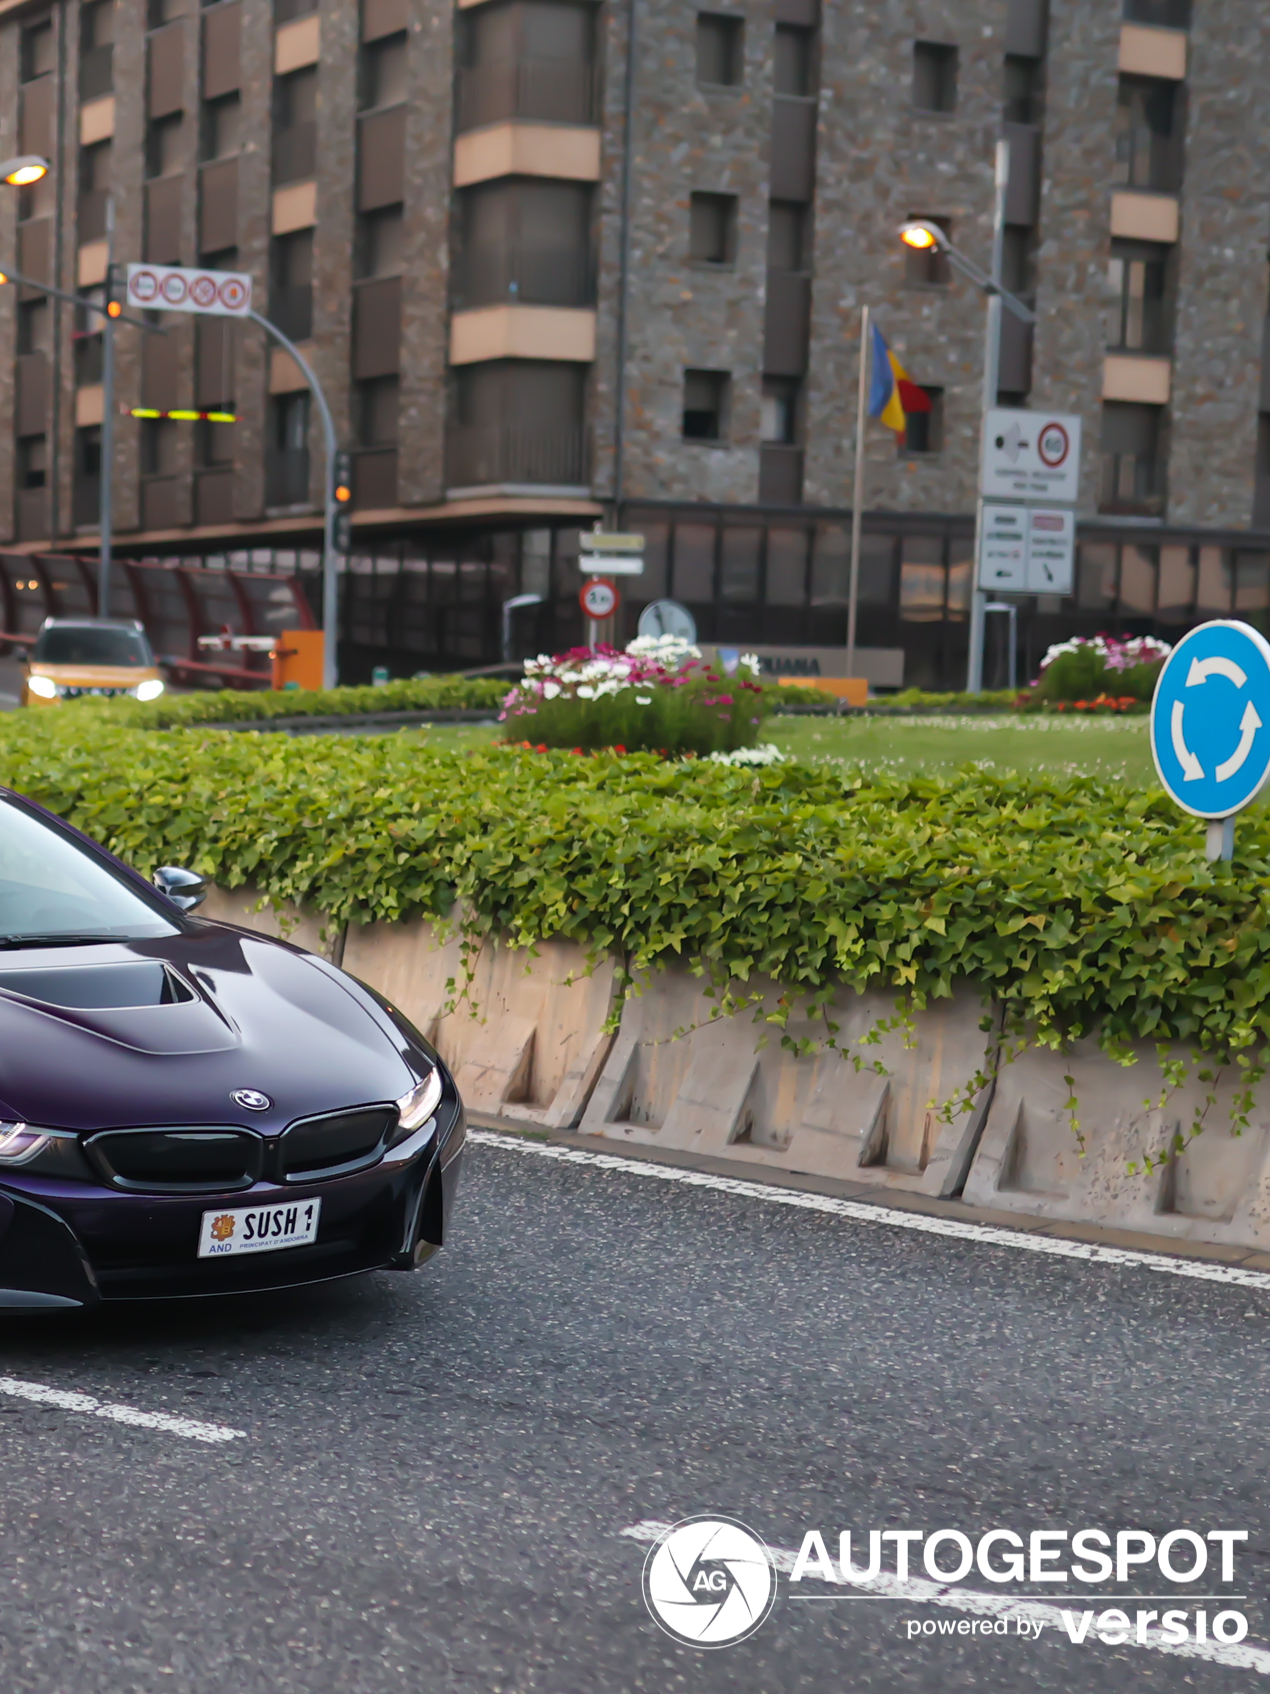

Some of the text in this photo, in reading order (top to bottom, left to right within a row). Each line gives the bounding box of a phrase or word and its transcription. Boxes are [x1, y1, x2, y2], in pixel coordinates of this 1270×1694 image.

[243, 1204, 313, 1240] SUSH 1
[208, 1243, 232, 1254] AND
[239, 1234, 309, 1249] PRINCIPAT D'ANDORRA
